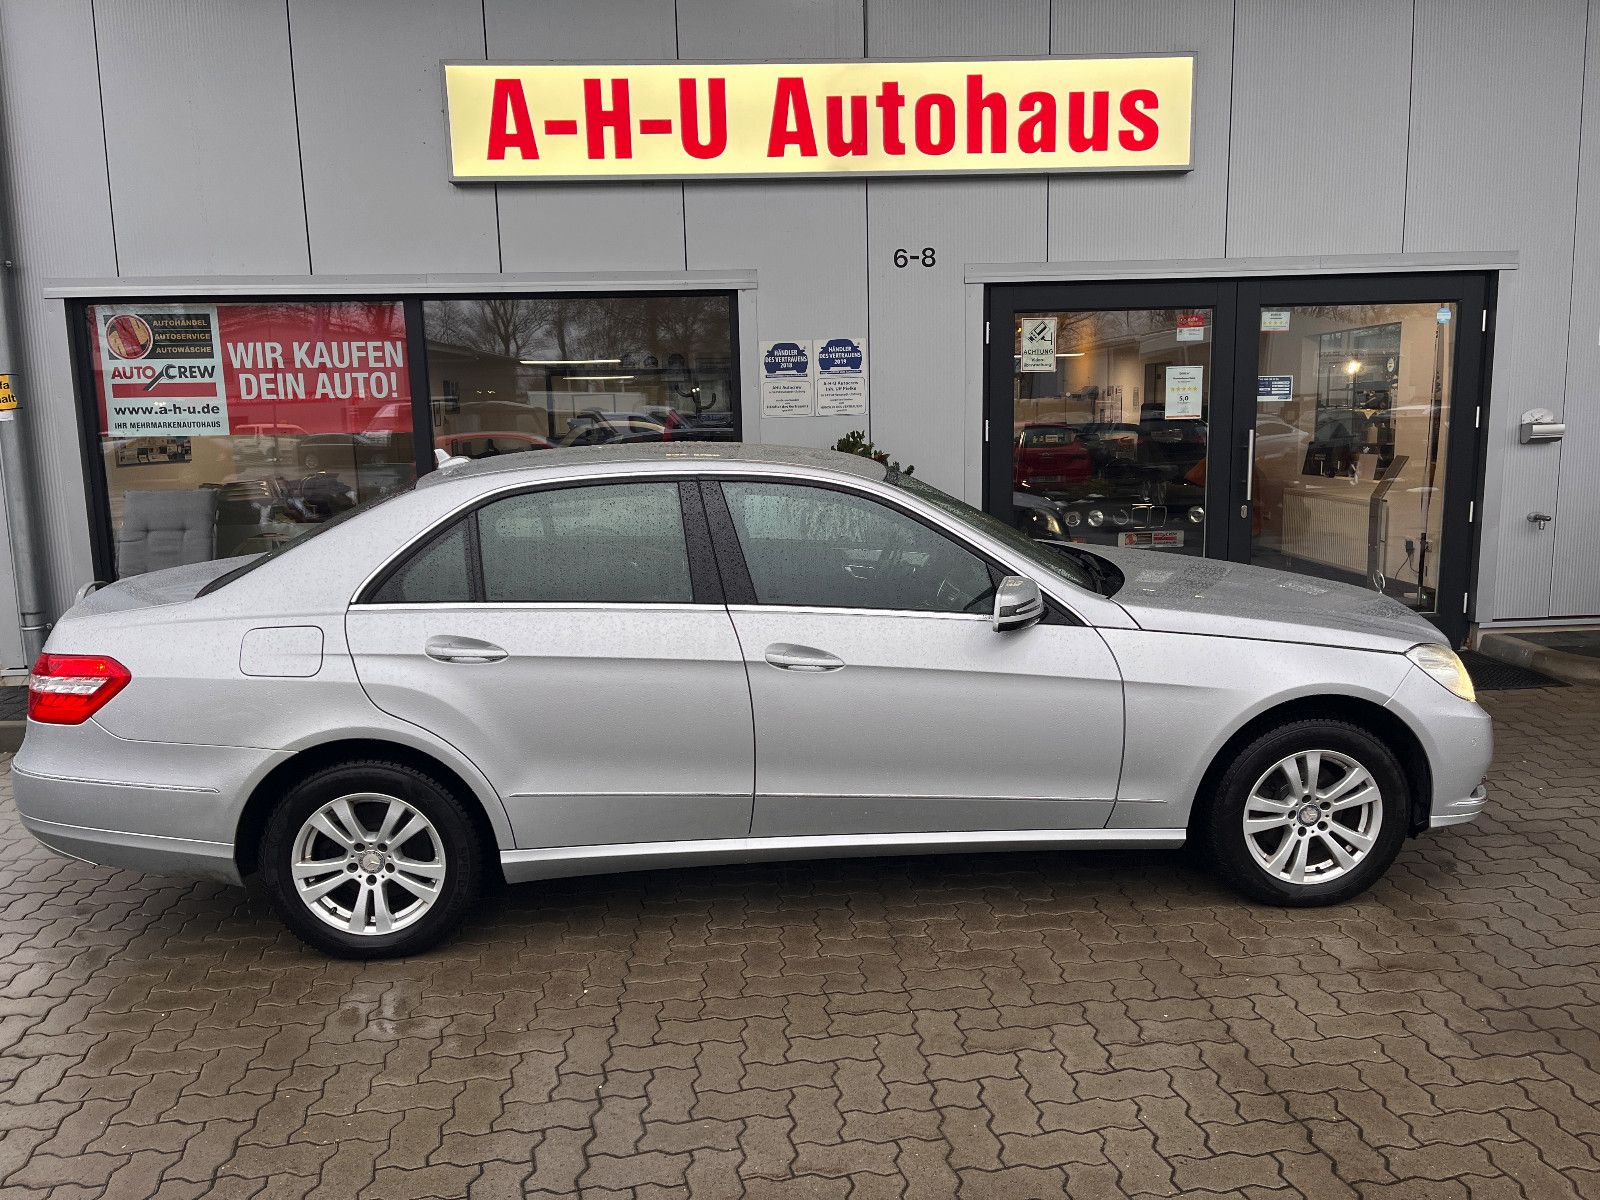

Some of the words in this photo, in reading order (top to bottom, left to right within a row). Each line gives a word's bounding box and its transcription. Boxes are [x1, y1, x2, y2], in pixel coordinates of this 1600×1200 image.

[486, 77, 729, 161] A-H-U
[766, 74, 1160, 159] Autohaus
[893, 247, 936, 268] 6-8
[152, 319, 208, 327] AUTOHANDEL
[154, 332, 211, 341] AUTOSERVICE
[156, 346, 212, 354] AUTOWÄSCHE
[774, 348, 798, 357] HÄNDLER
[828, 345, 852, 353] HÄNDLER
[227, 341, 285, 369] WIR
[292, 340, 404, 369] KAUFEN
[775, 355, 808, 363] VERTRAUENS
[111, 366, 156, 380] AUTO
[239, 372, 306, 400] DEIN
[315, 371, 399, 400] AUTO!
[0, 394, 17, 404] alt
[114, 404, 220, 416] www.a-h-u.de
[114, 422, 128, 430] IHR
[129, 420, 221, 430] MEHRMARKENAUTOHAUS
